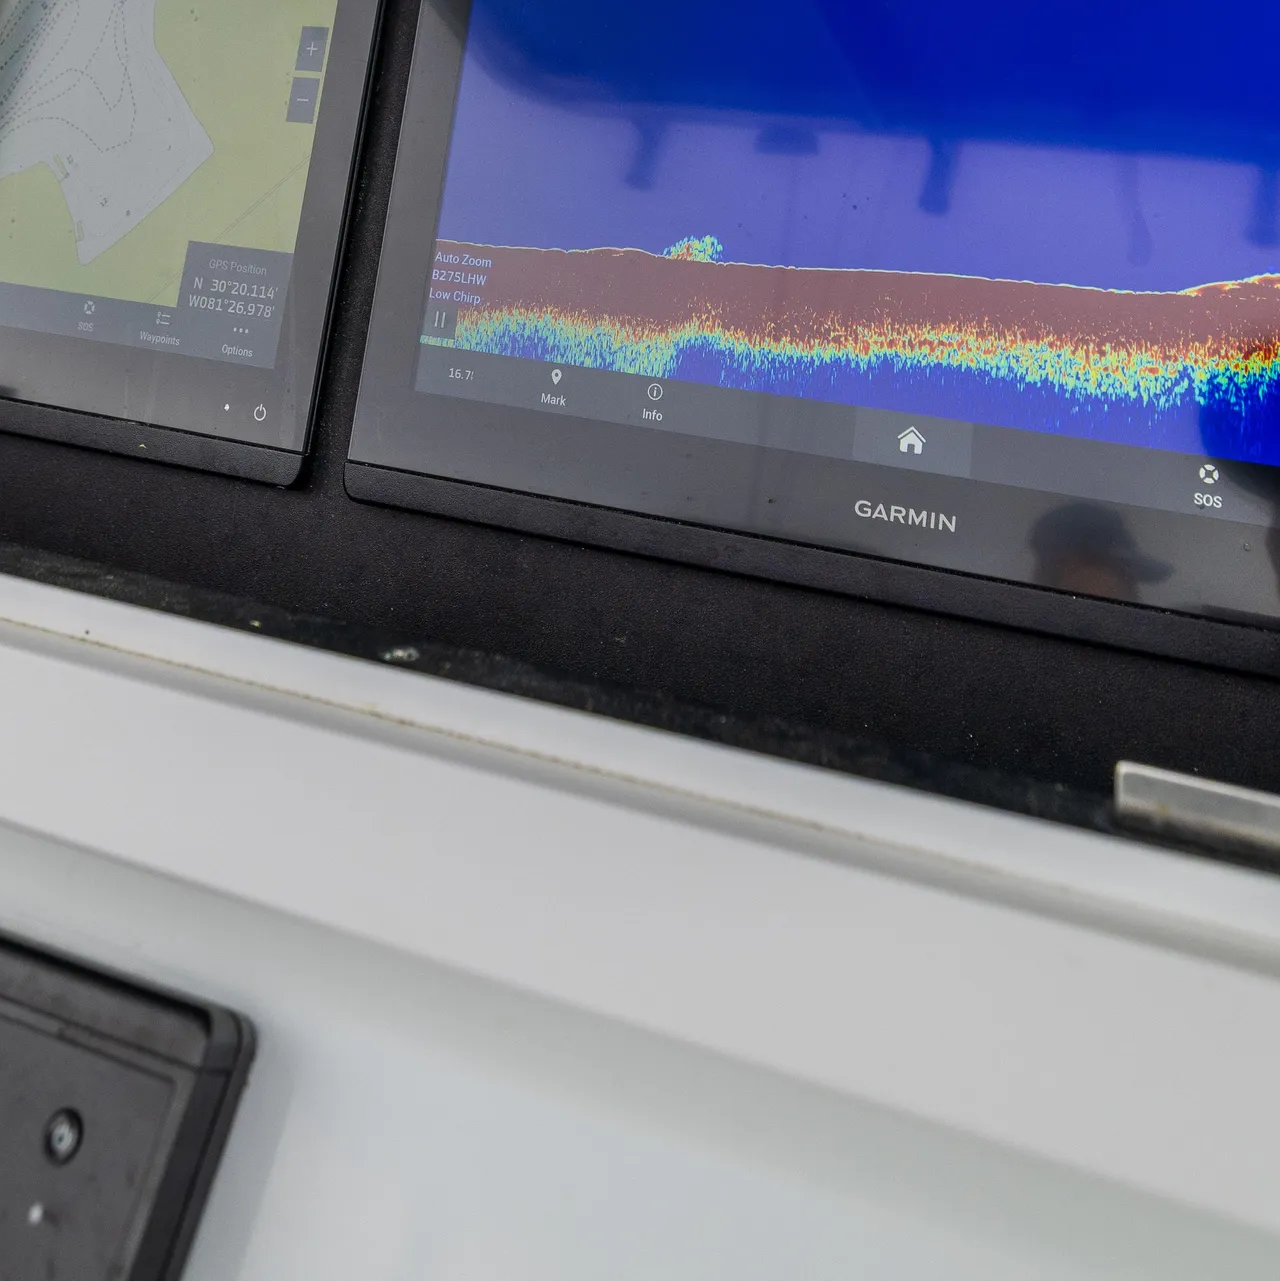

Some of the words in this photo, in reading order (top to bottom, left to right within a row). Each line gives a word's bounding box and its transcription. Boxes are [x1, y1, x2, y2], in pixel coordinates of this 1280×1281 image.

[209, 259, 228, 271] GPS
[230, 261, 267, 276] Position
[434, 251, 460, 264] Auto
[461, 254, 492, 268] Zoom
[193, 277, 204, 289] N
[432, 269, 487, 286] B275LHW
[429, 287, 451, 300] Low
[453, 290, 481, 306] Chirp
[77, 321, 93, 332] SOS
[140, 330, 180, 346] Waypoints
[221, 344, 253, 357] Options
[541, 392, 567, 407] Mark
[642, 408, 663, 421] Info
[1193, 492, 1223, 508] SOS
[854, 500, 956, 533] GARMIN
